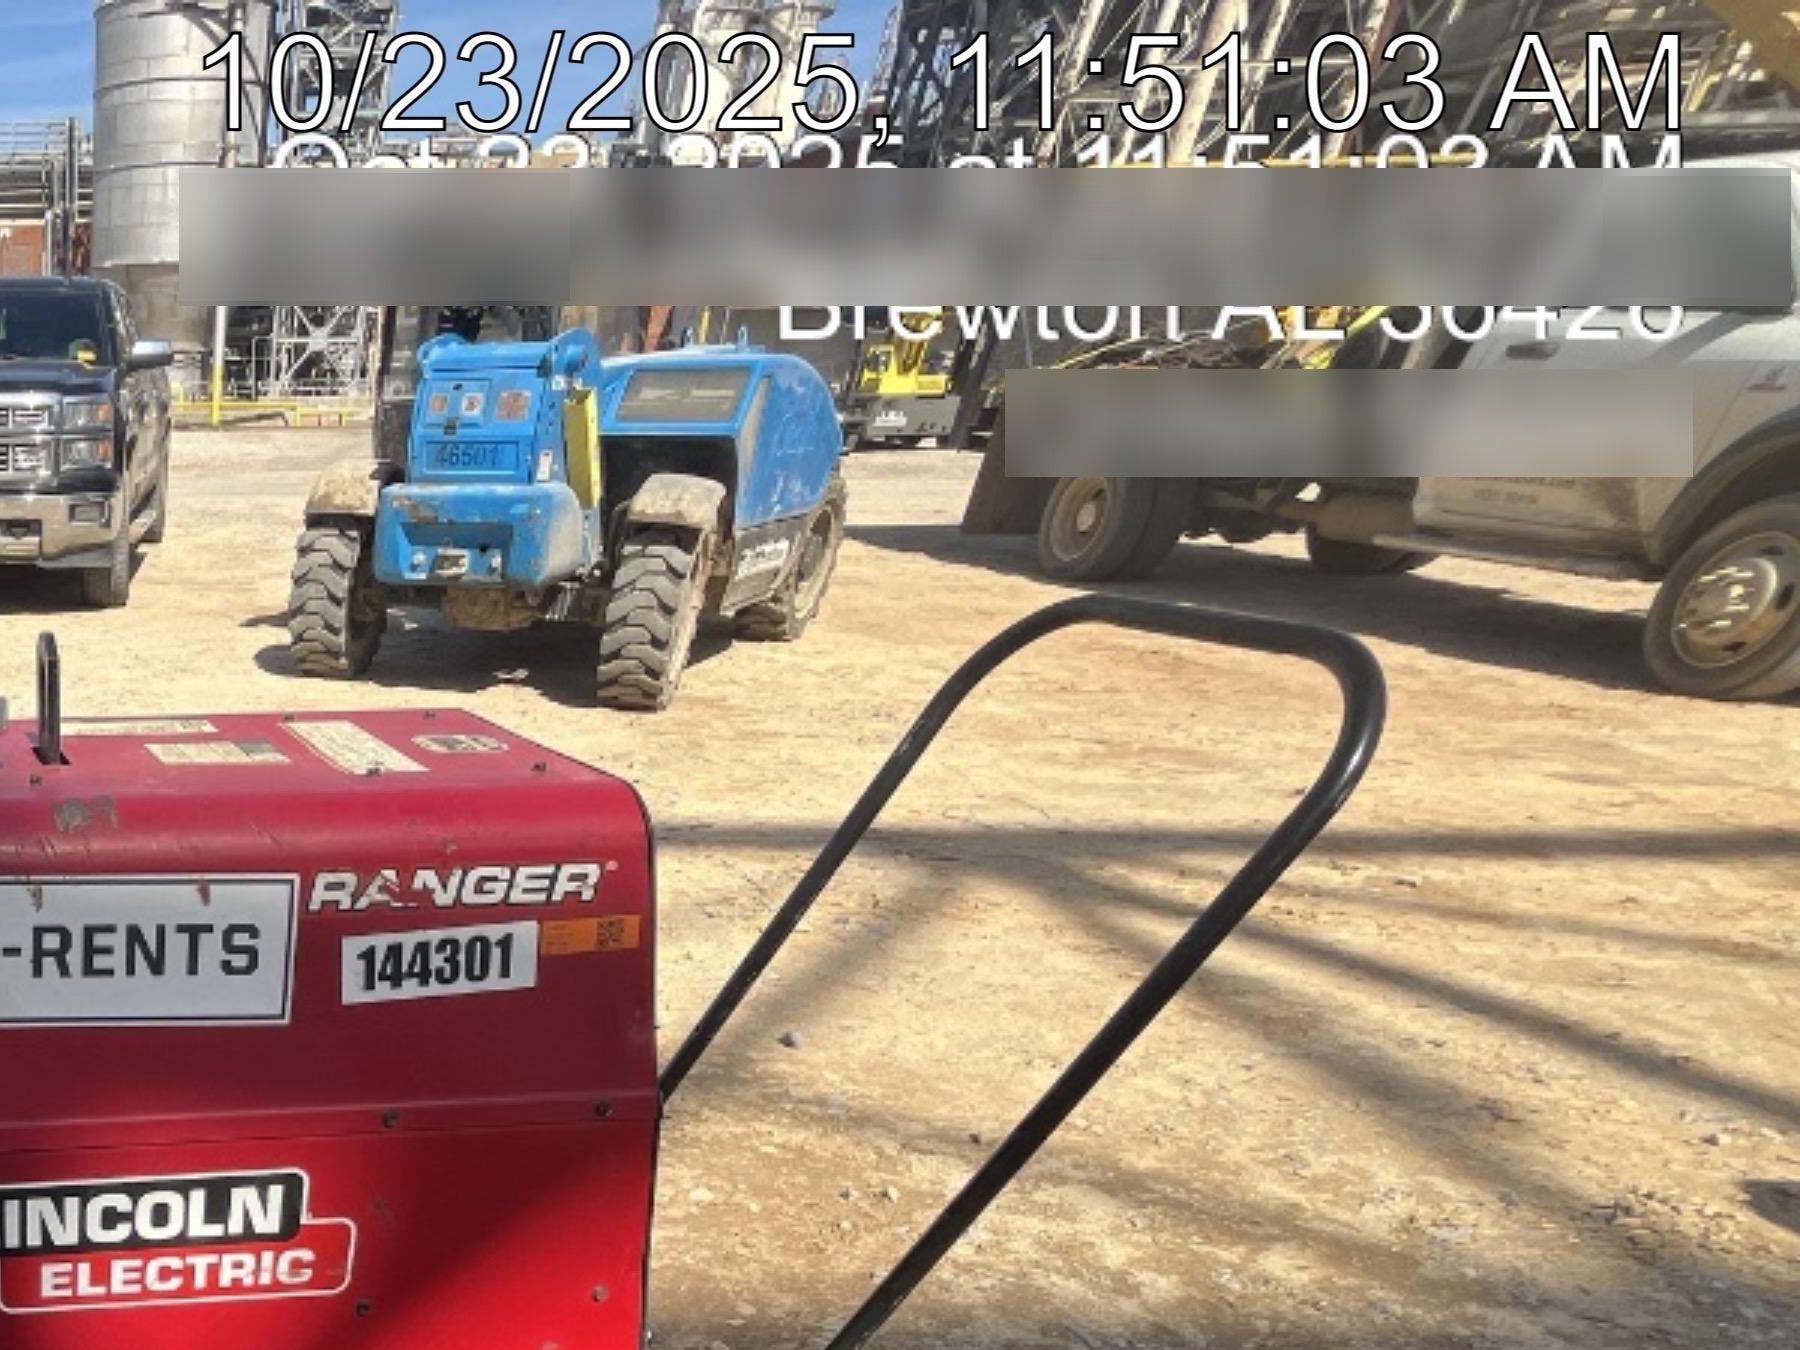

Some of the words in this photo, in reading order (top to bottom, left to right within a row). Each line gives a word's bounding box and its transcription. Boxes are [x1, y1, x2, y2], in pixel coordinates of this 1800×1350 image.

[308, 863, 602, 912] RANGER
[355, 931, 515, 991] 144301
[40, 1247, 316, 1298] ELECTRIC
